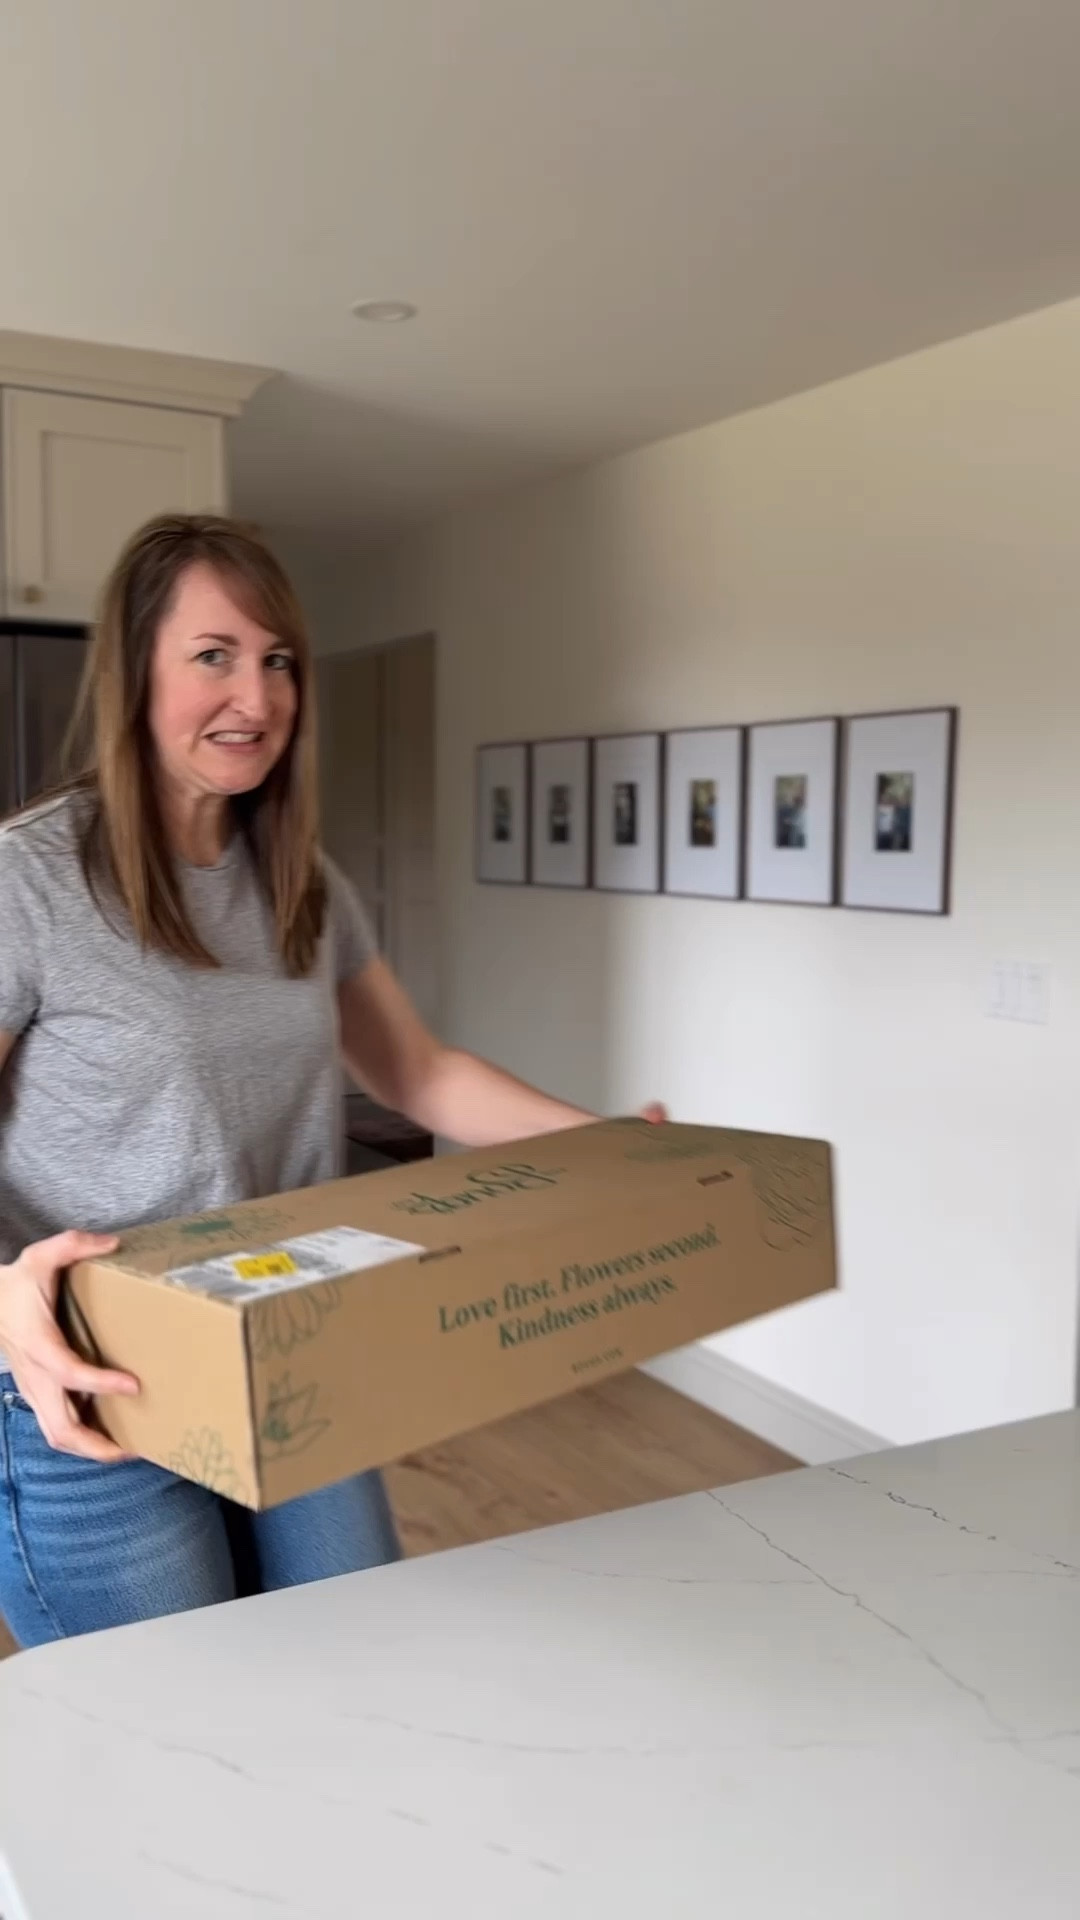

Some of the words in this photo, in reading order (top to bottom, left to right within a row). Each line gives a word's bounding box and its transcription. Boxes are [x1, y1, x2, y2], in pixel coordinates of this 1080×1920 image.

[438, 1297, 497, 1333] Love
[560, 1250, 646, 1293] Flowers
[498, 1299, 600, 1349] Kindness
